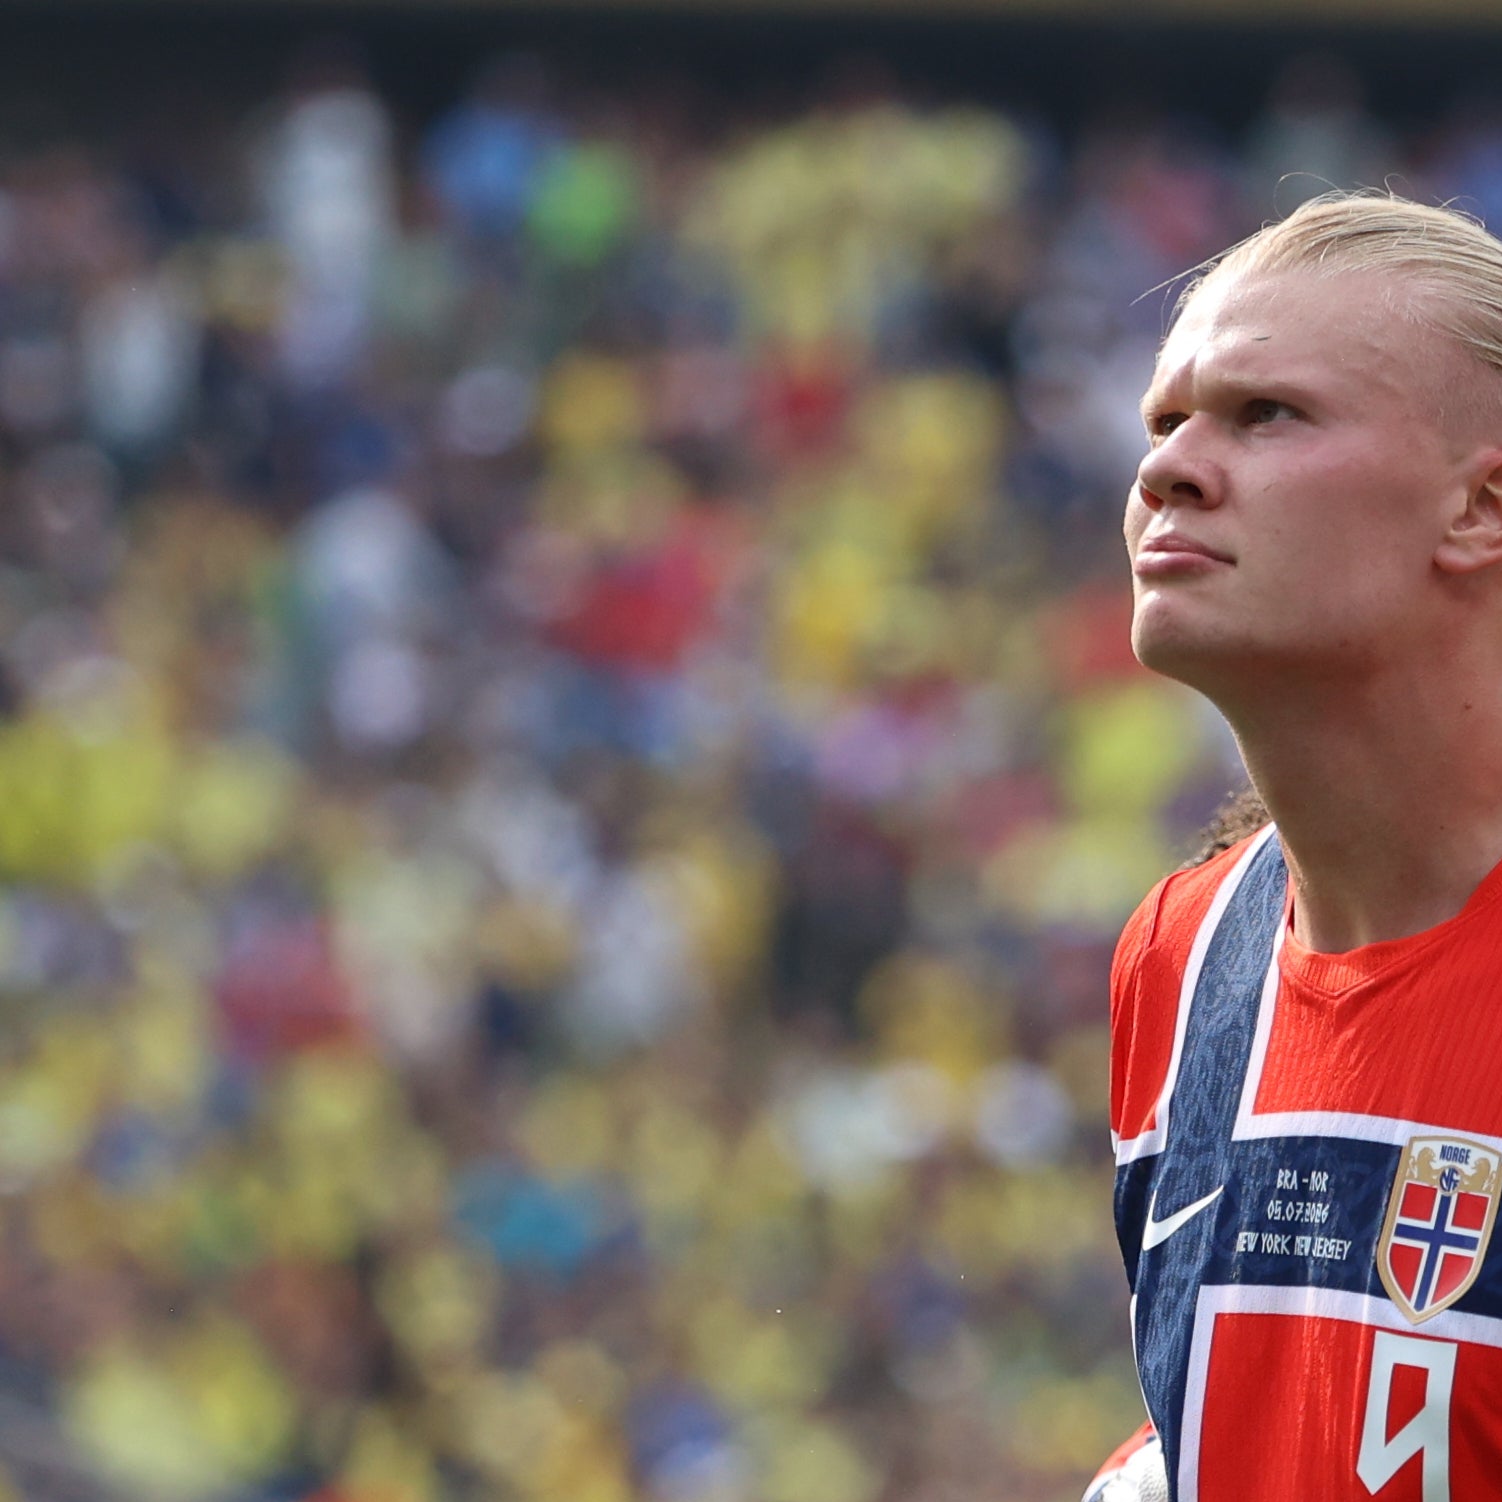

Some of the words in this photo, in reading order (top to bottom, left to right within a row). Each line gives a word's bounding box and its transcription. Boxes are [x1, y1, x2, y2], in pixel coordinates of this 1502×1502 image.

[1440, 1144, 1471, 1165] NORGE
[1276, 1168, 1298, 1190] BRA
[1309, 1170, 1329, 1192] NOR
[1267, 1200, 1330, 1224] 05.07.2026
[1261, 1233, 1292, 1255] YORK
[1294, 1235, 1312, 1256] NEW
[1312, 1236, 1352, 1261] JERSEY
